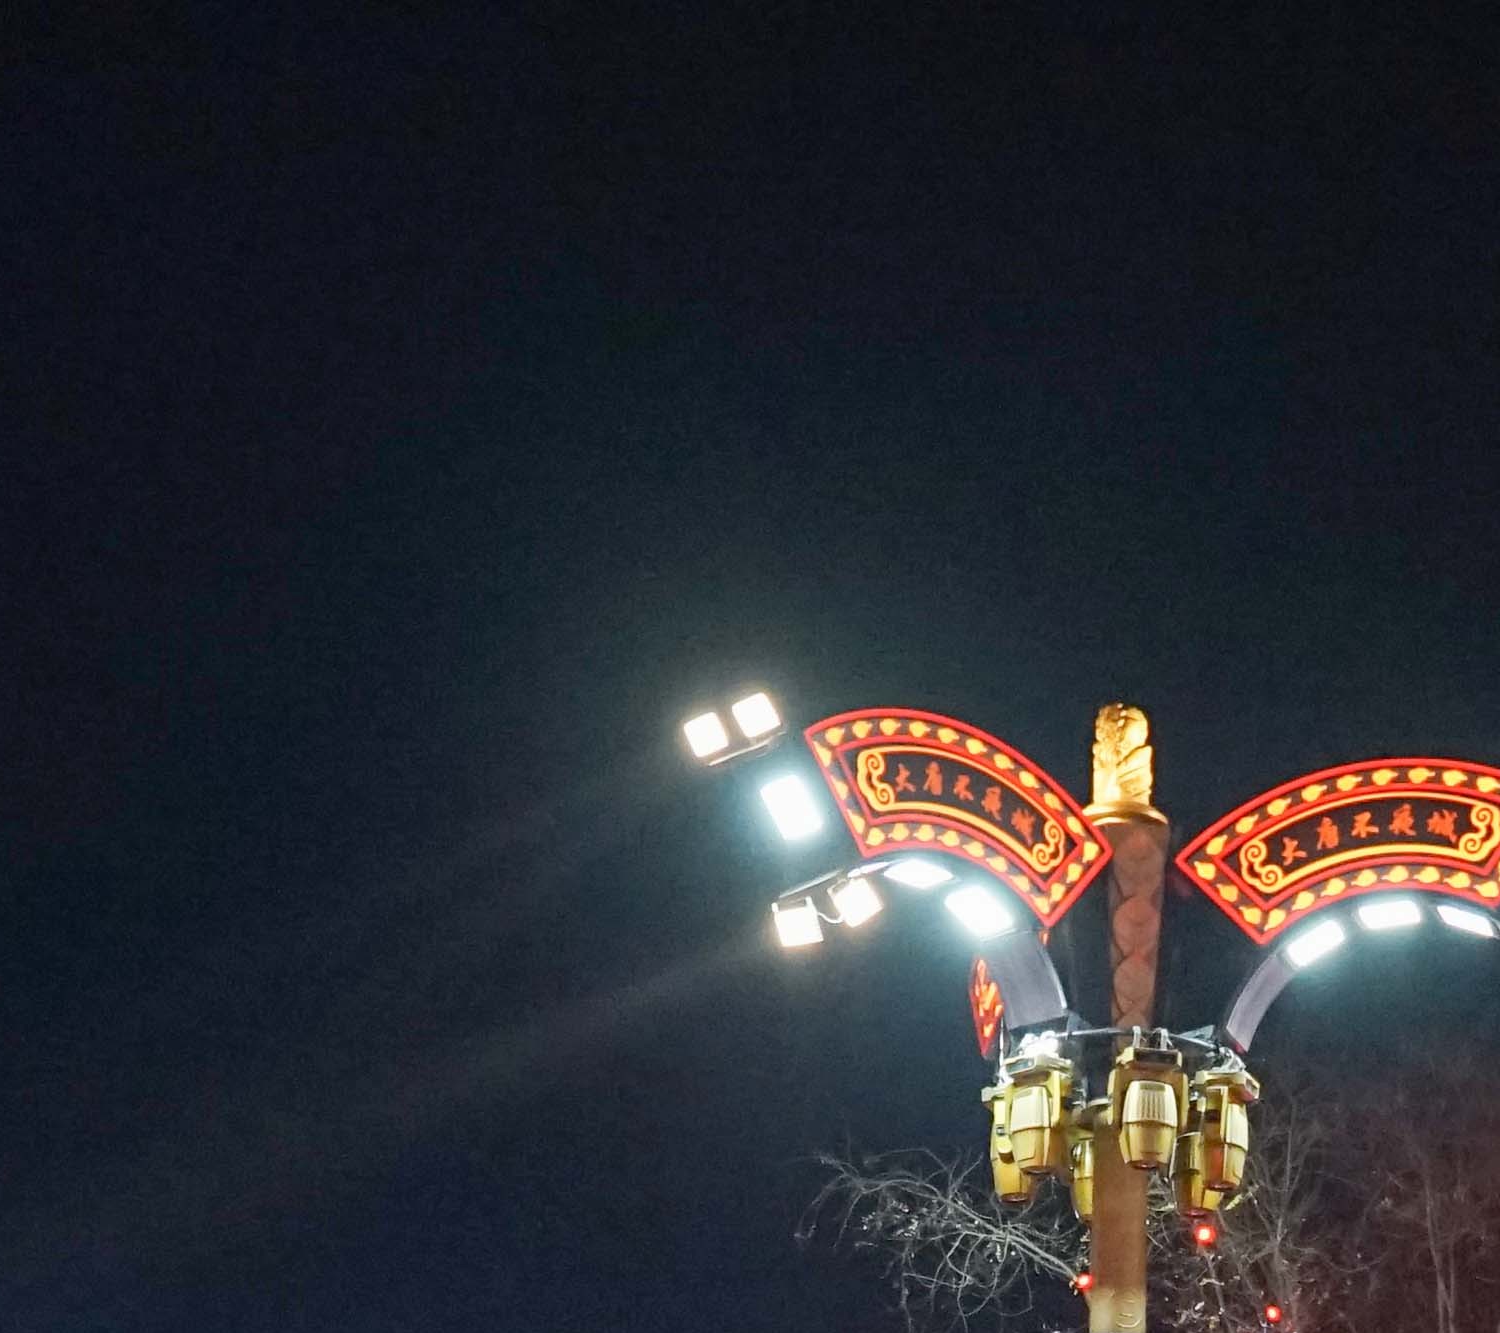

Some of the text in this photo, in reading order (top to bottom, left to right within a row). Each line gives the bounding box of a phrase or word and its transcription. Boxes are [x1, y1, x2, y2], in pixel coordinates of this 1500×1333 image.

[1281, 803, 1457, 866] 大唐不夜城
